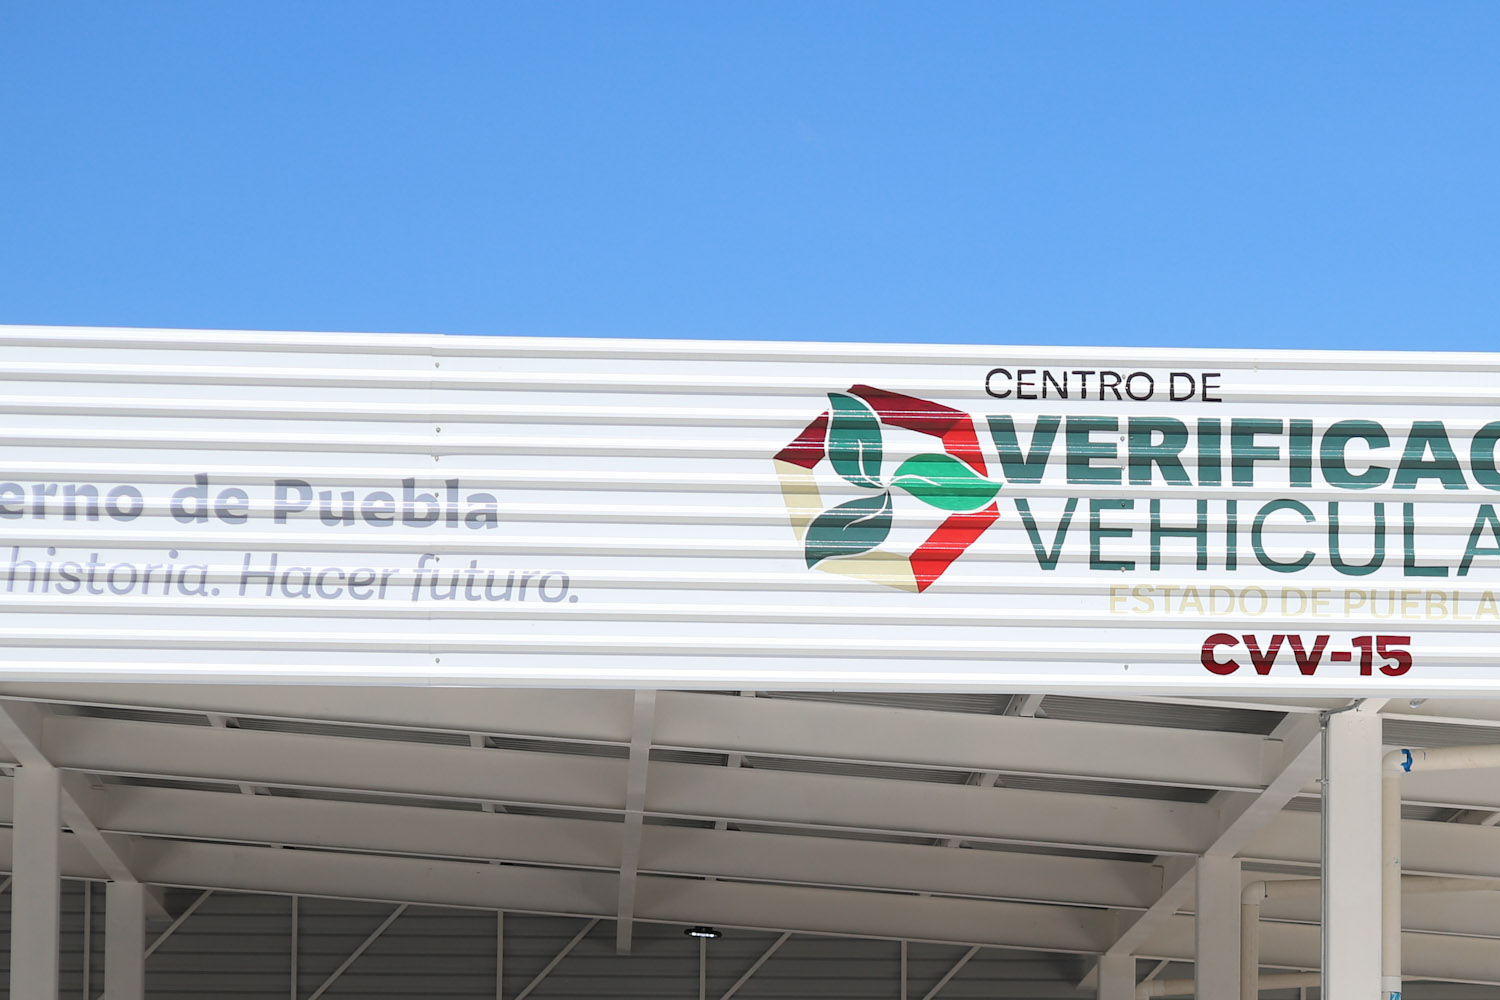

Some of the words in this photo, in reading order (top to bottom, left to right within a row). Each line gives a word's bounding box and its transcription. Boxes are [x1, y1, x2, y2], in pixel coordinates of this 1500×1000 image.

[984, 368, 1154, 402] CENTRO
[1168, 371, 1222, 403] DE
[169, 472, 249, 525] de
[274, 477, 499, 530] Puebla
[6, 545, 220, 597] historia.
[238, 552, 400, 600] Hacer
[411, 552, 579, 604] futuro.
[1109, 583, 1268, 617] ESTADO
[1281, 586, 1332, 618] DE
[1344, 587, 1500, 620] PUEBLA
[1200, 633, 1413, 677] CVV-15
